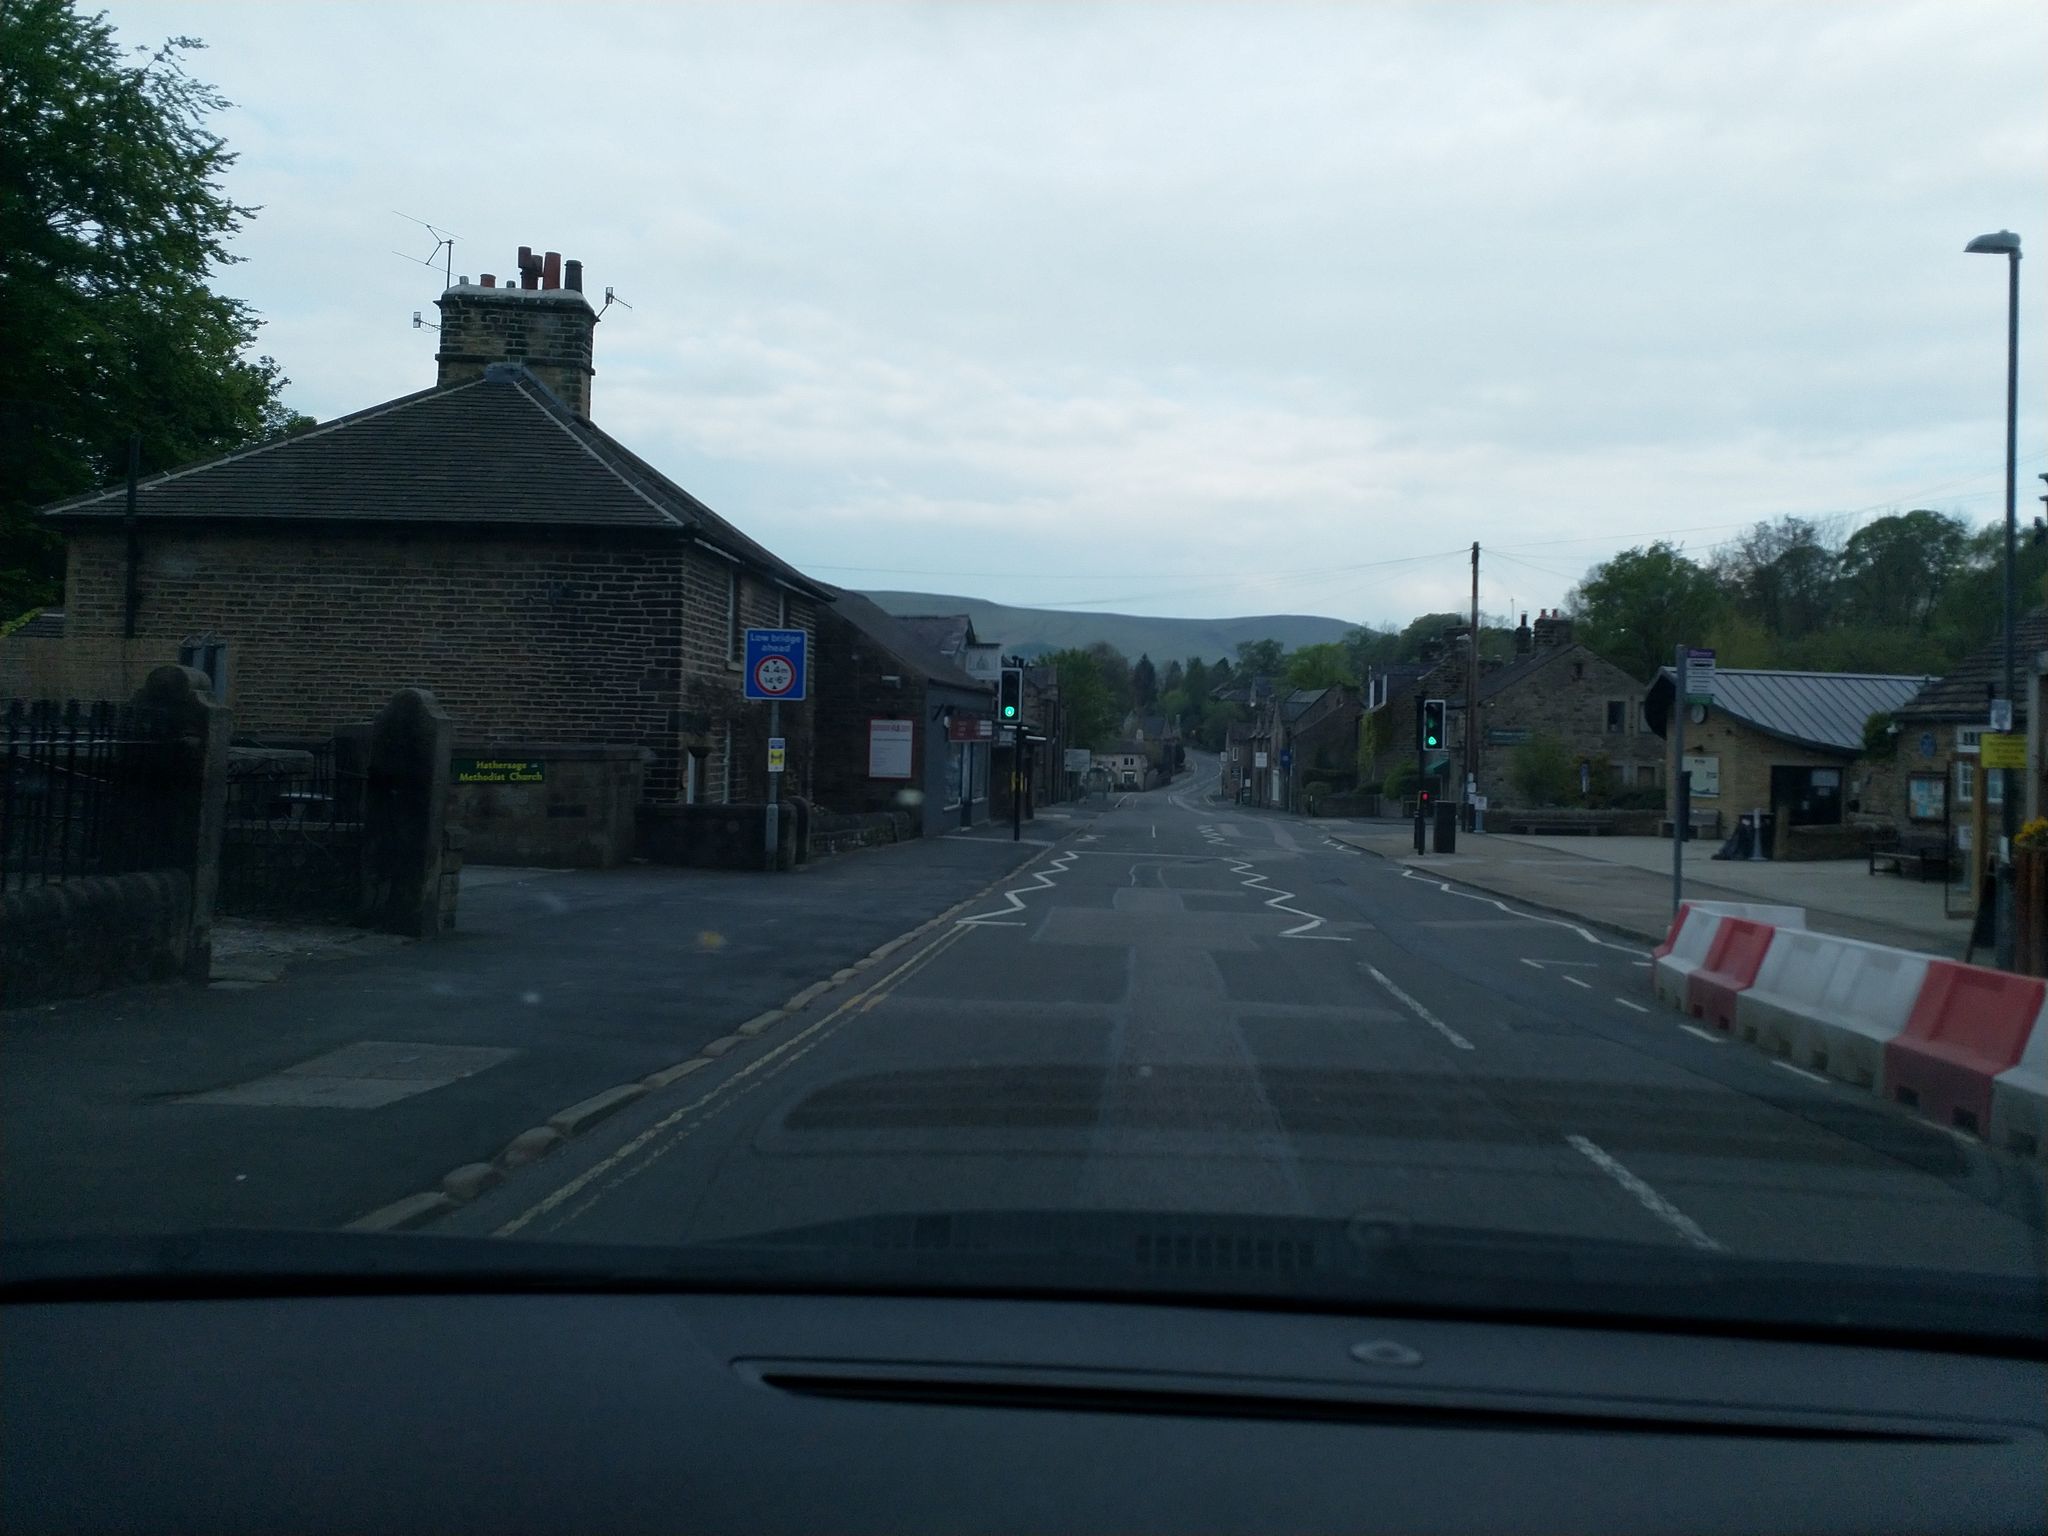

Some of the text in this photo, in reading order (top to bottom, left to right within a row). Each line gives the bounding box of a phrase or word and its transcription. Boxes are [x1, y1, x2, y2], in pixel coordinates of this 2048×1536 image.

[750, 632, 801, 645] Low bridge
[761, 643, 791, 653] ahead
[476, 760, 528, 771] Hathersage
[459, 770, 543, 781] Methodist Church
